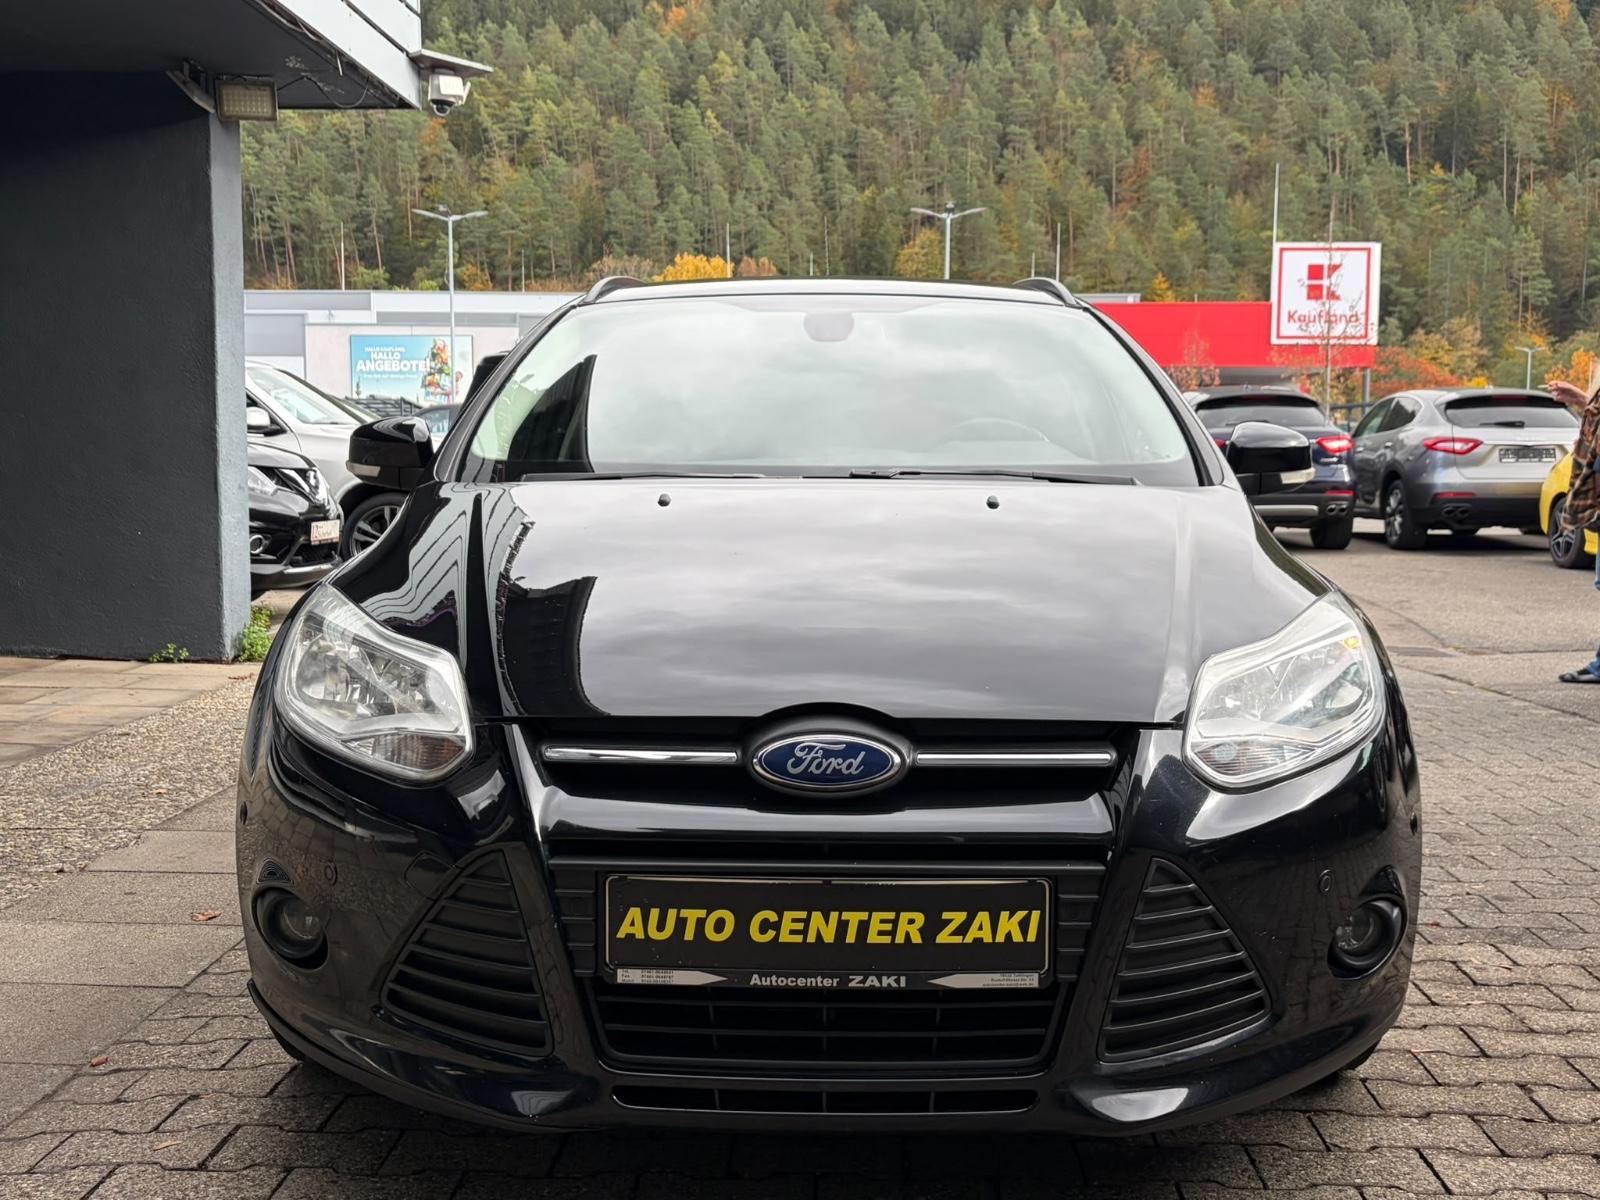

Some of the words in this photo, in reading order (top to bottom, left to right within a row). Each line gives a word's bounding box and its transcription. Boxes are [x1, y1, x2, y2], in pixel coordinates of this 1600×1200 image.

[1287, 310, 1359, 324] Kaufland
[370, 351, 401, 360] HALLO
[356, 358, 430, 372] ANGEBOTE!
[786, 742, 866, 774] Ford
[616, 907, 736, 942] AUTO
[749, 910, 925, 944] CENTER
[935, 910, 1041, 944] ZAKI
[749, 973, 840, 987] Autocenter
[848, 975, 907, 988] ZAKI
